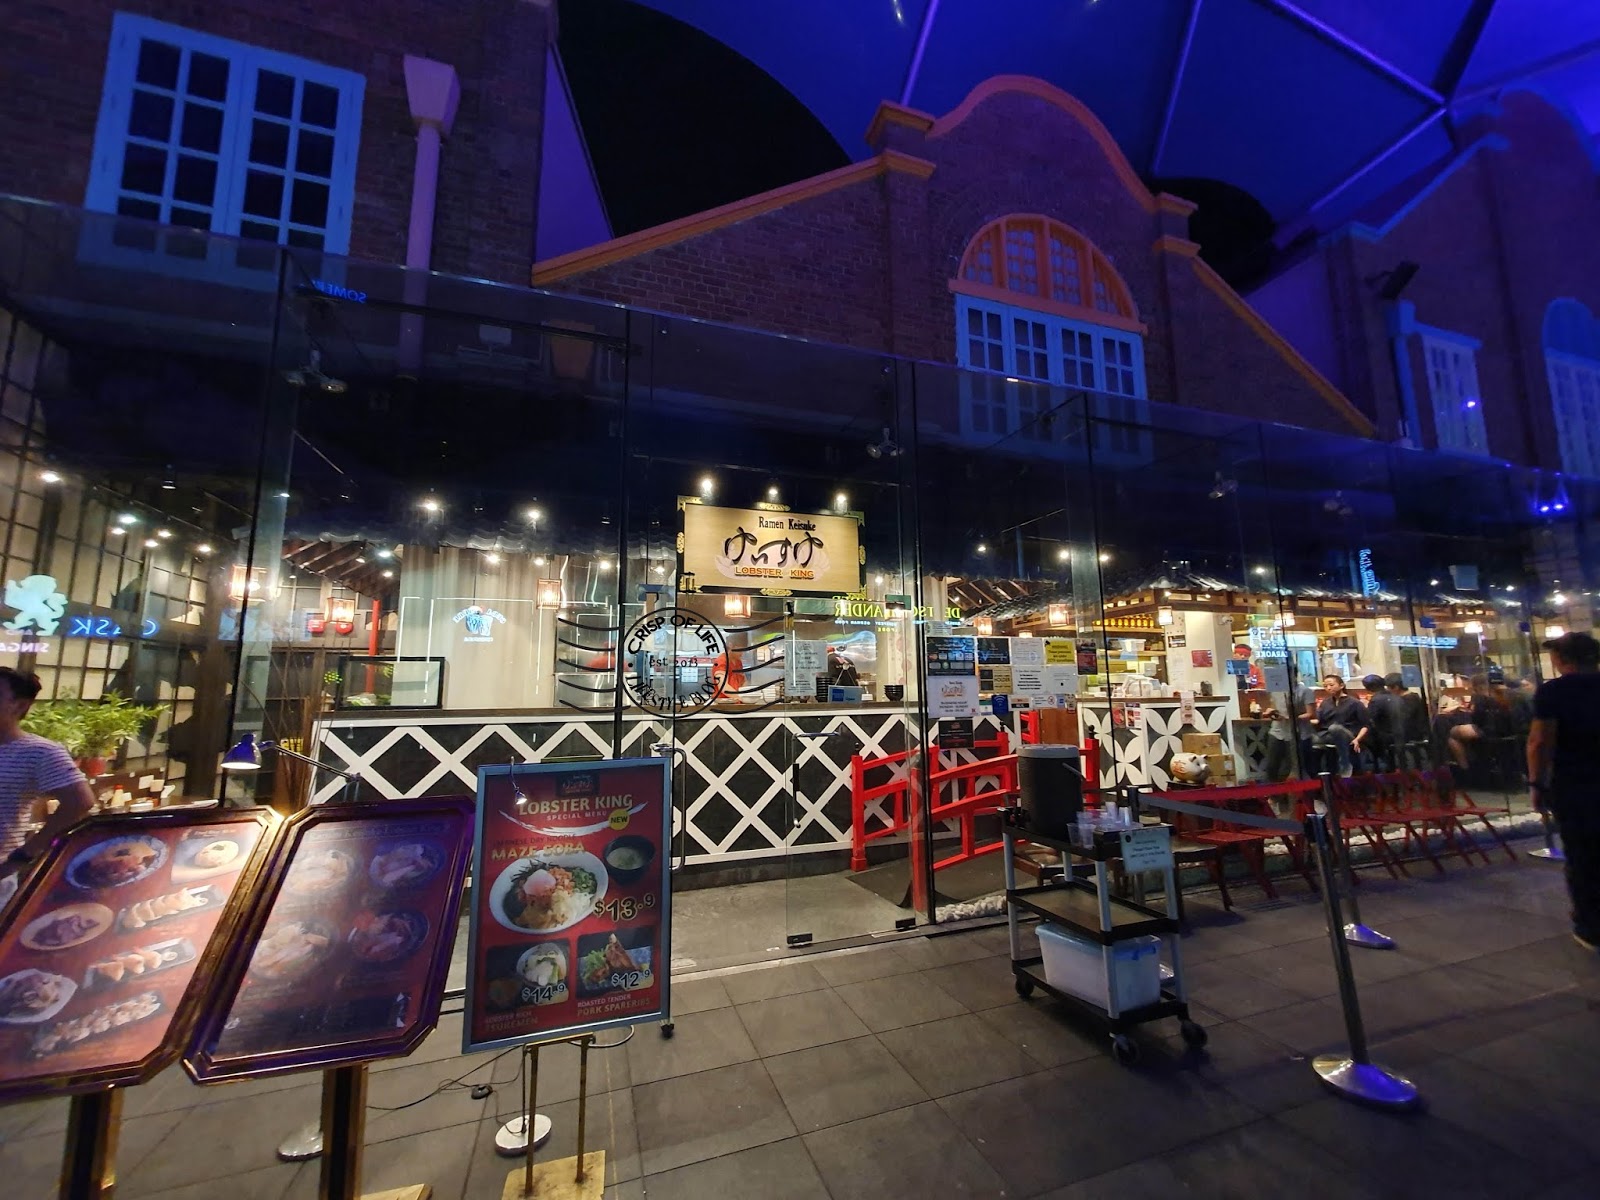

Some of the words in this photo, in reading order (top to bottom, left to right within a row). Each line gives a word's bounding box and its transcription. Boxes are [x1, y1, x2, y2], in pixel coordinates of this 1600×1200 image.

[758, 516, 784, 529] Ramen
[788, 518, 817, 531] Keisuke
[735, 567, 782, 577] LOBSTER
[790, 570, 814, 579] KING
[519, 798, 590, 815] LOBSTER
[595, 794, 633, 809] KING
[546, 813, 581, 821] SPECIAL
[585, 810, 608, 818] MENU
[610, 815, 628, 823] NEW
[491, 846, 538, 860] MAZE
[543, 842, 585, 856] SOBA
[577, 998, 606, 1008] ROASTED
[608, 993, 631, 1003] TENDER
[577, 1006, 602, 1017] PORK
